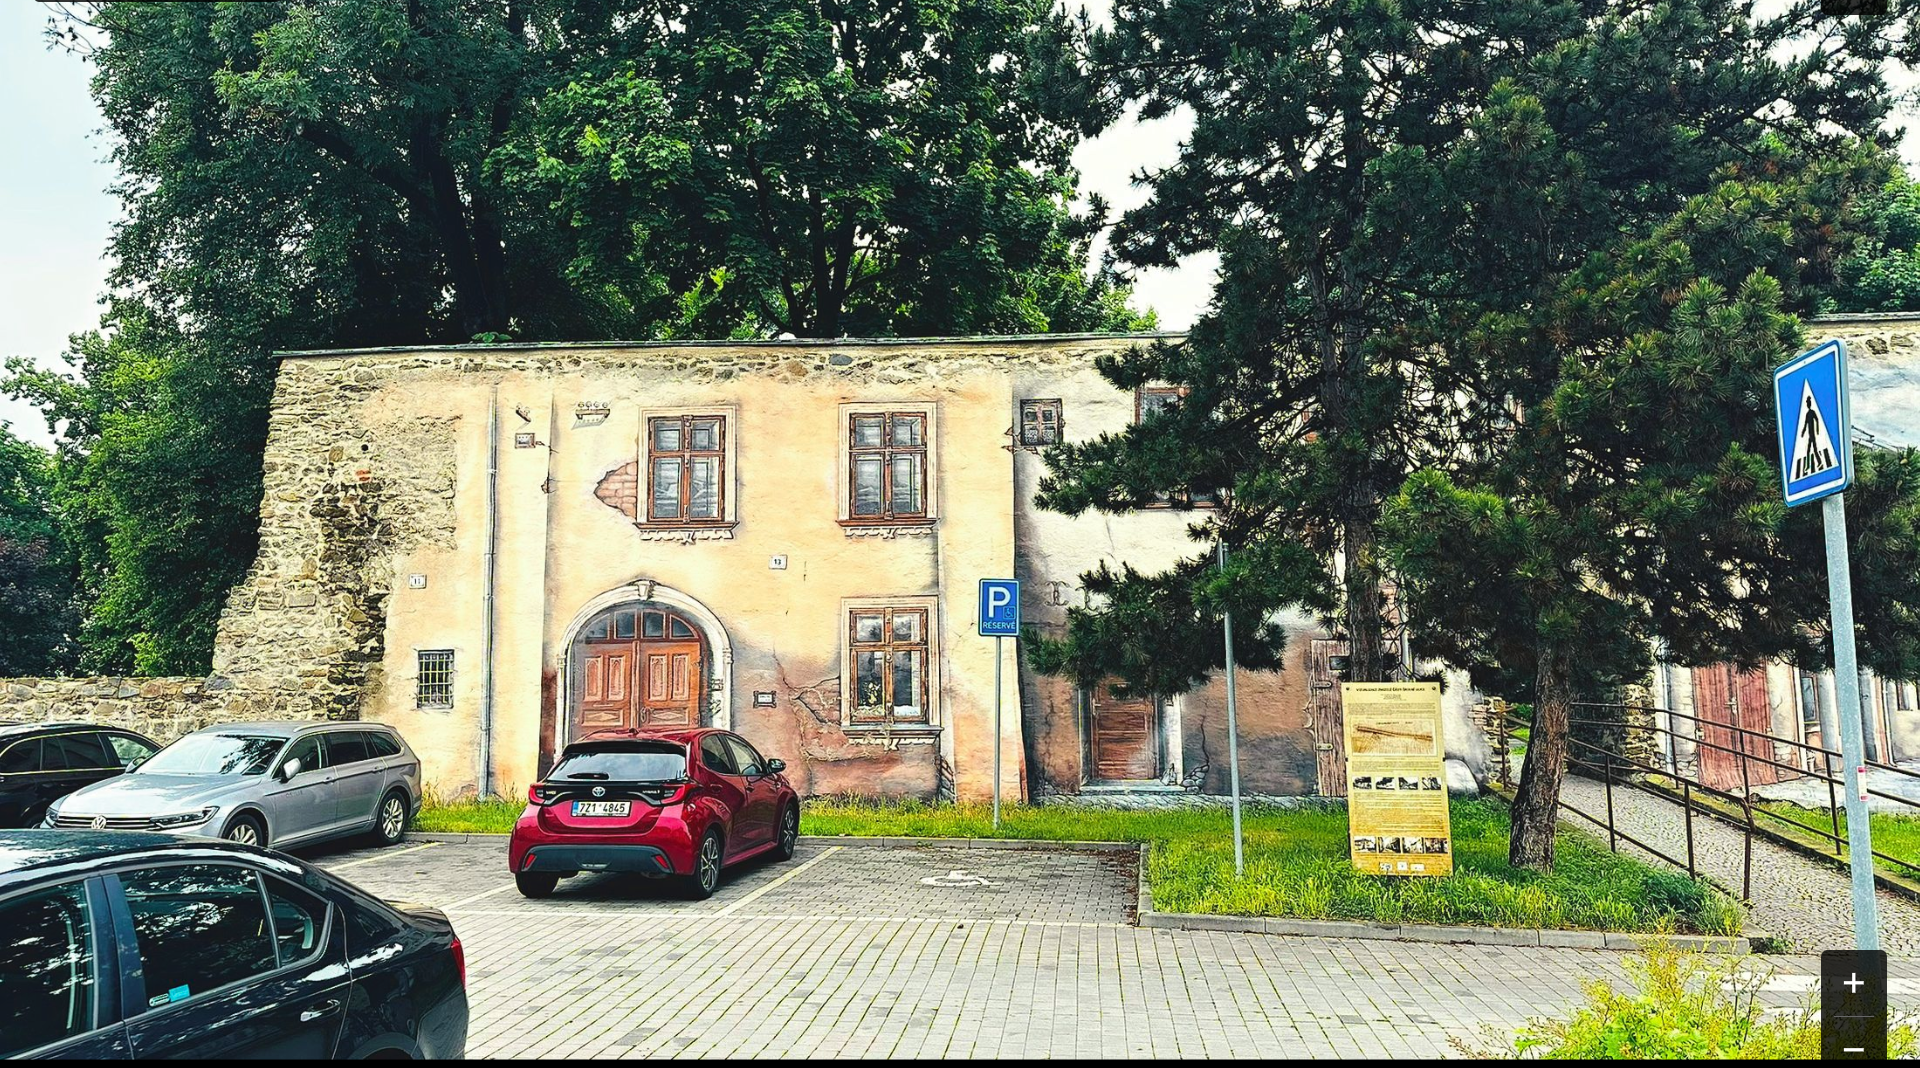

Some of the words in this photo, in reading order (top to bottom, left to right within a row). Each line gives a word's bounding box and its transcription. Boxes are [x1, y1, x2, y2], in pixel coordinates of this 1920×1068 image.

[988, 586, 1010, 618] P
[982, 620, 1016, 630] RÉSERVÉ
[580, 803, 597, 812] 7Z1
[602, 803, 625, 812] 4845
